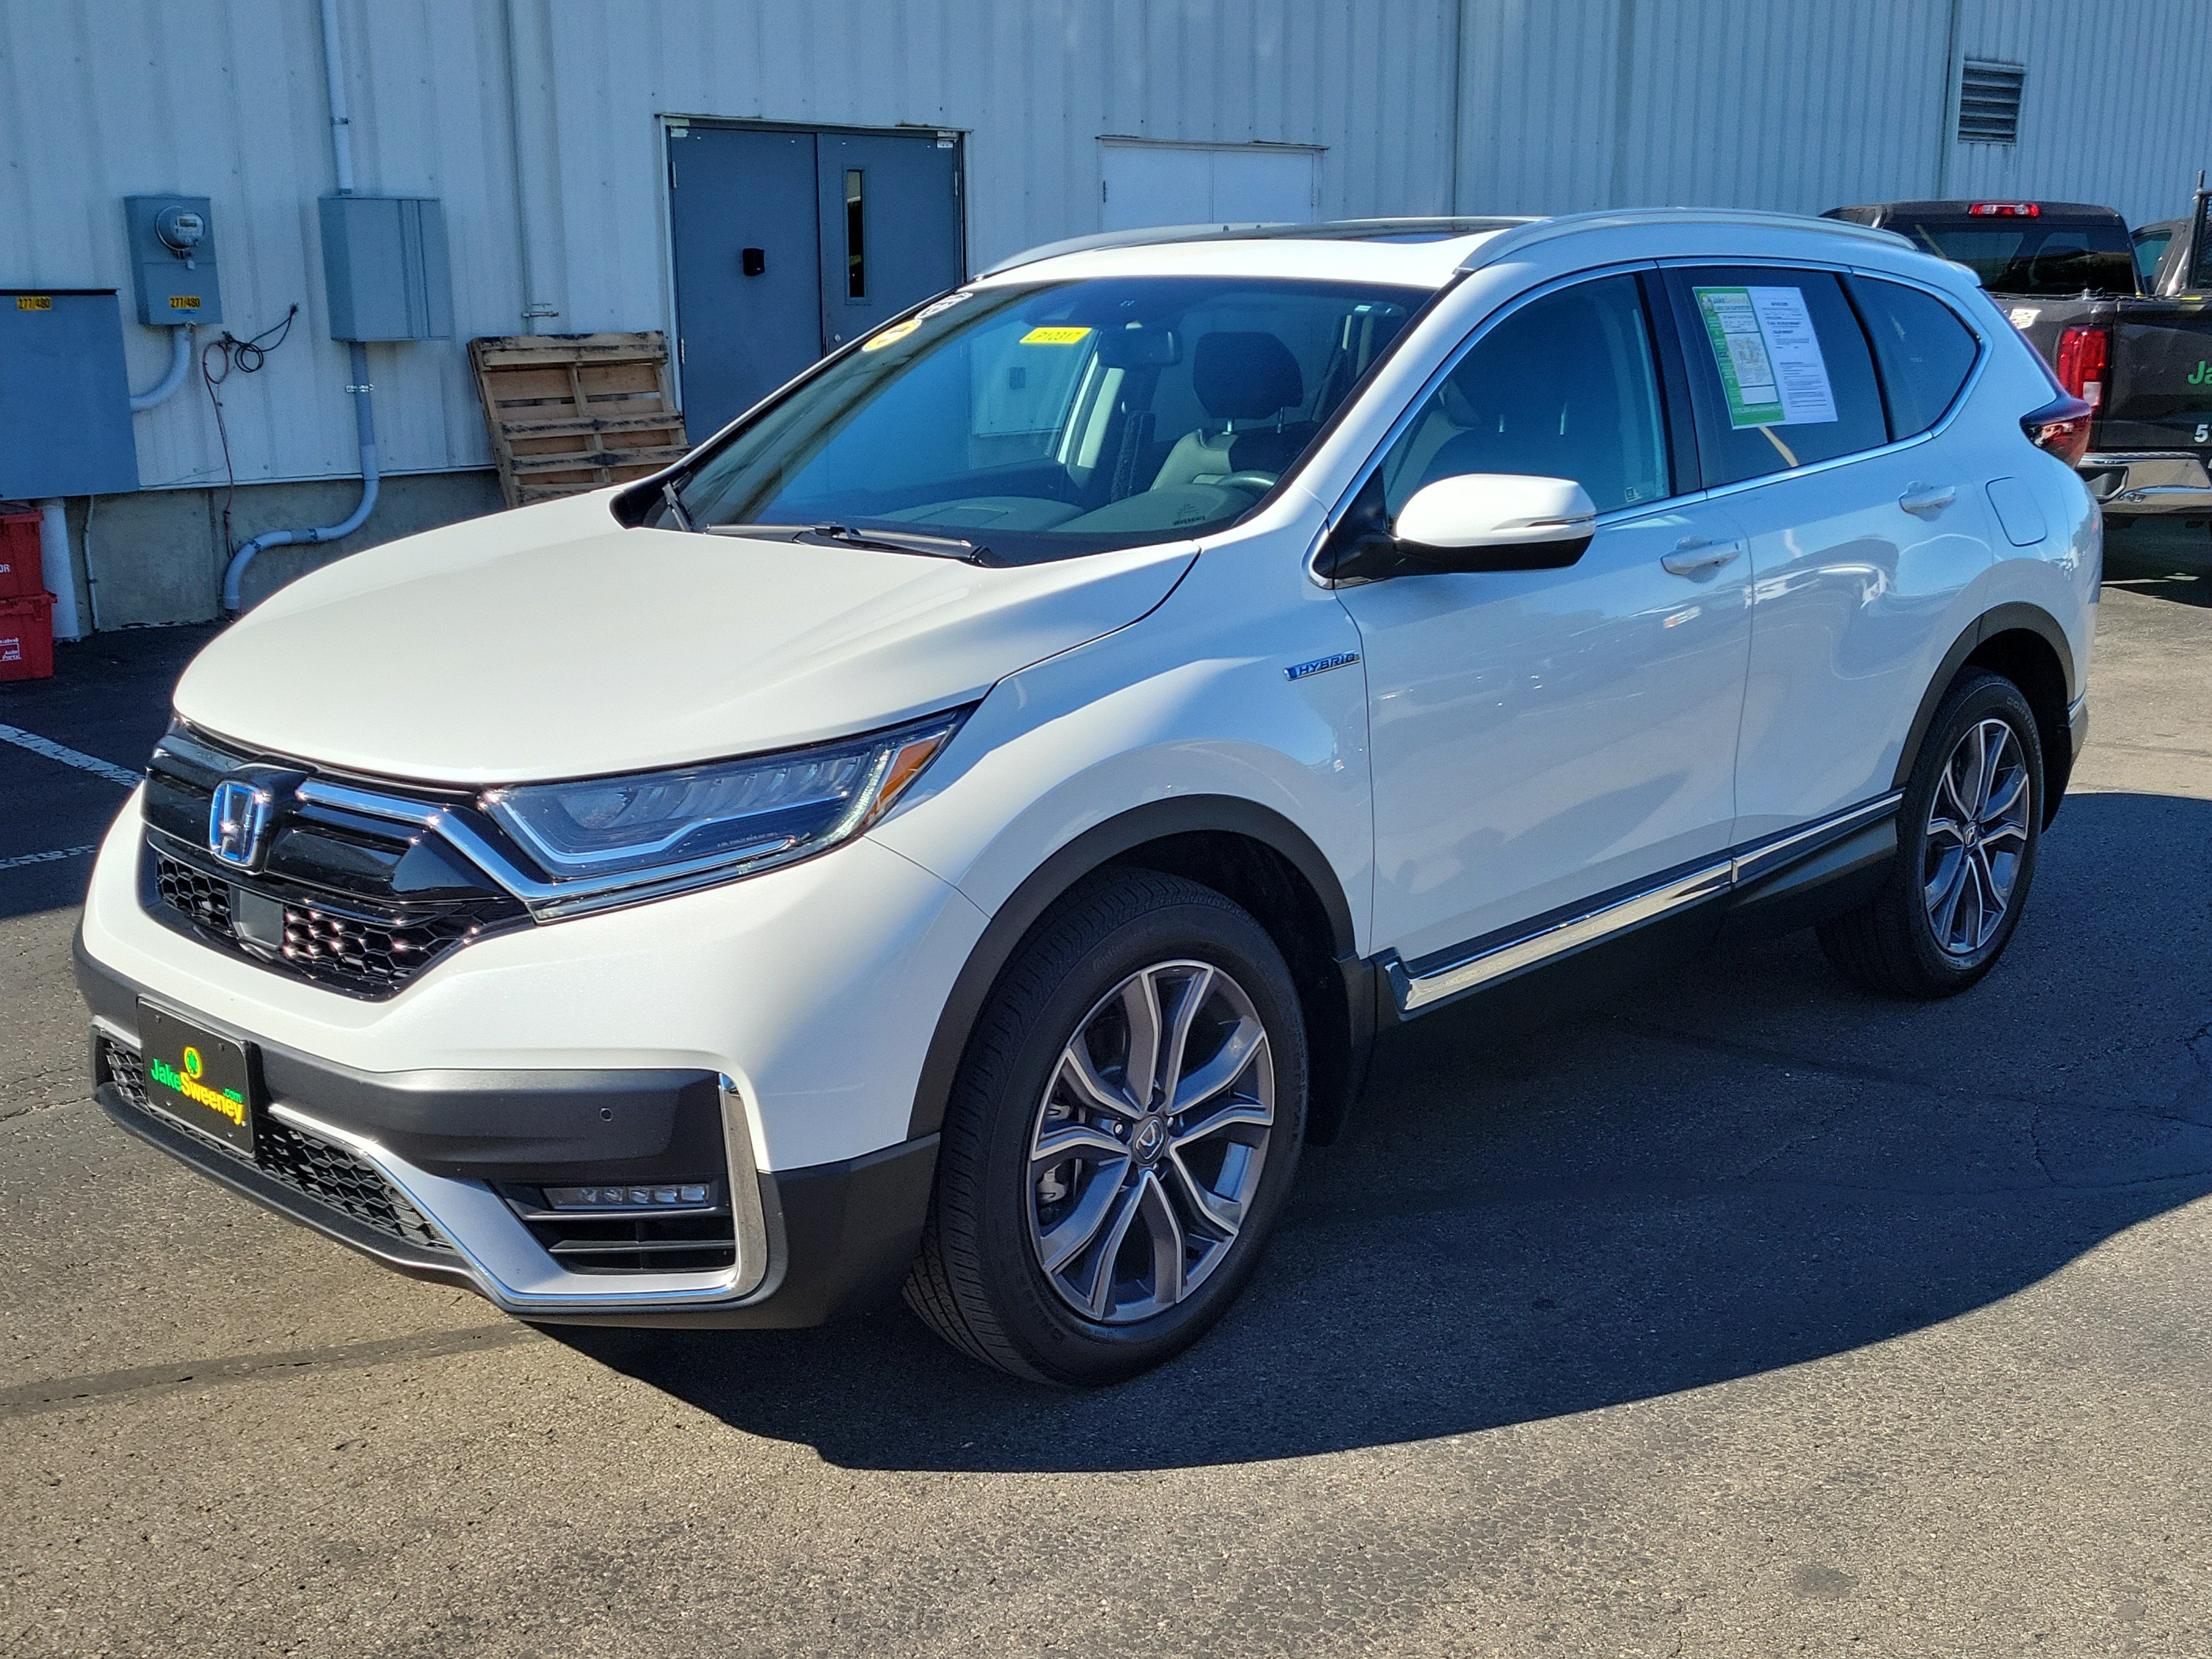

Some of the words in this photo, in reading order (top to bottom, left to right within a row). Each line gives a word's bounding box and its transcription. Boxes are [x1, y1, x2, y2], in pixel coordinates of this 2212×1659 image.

[170, 297, 200, 308] 277/480
[2194, 424, 2212, 443] 5
[1299, 653, 1355, 675] HYBRID
